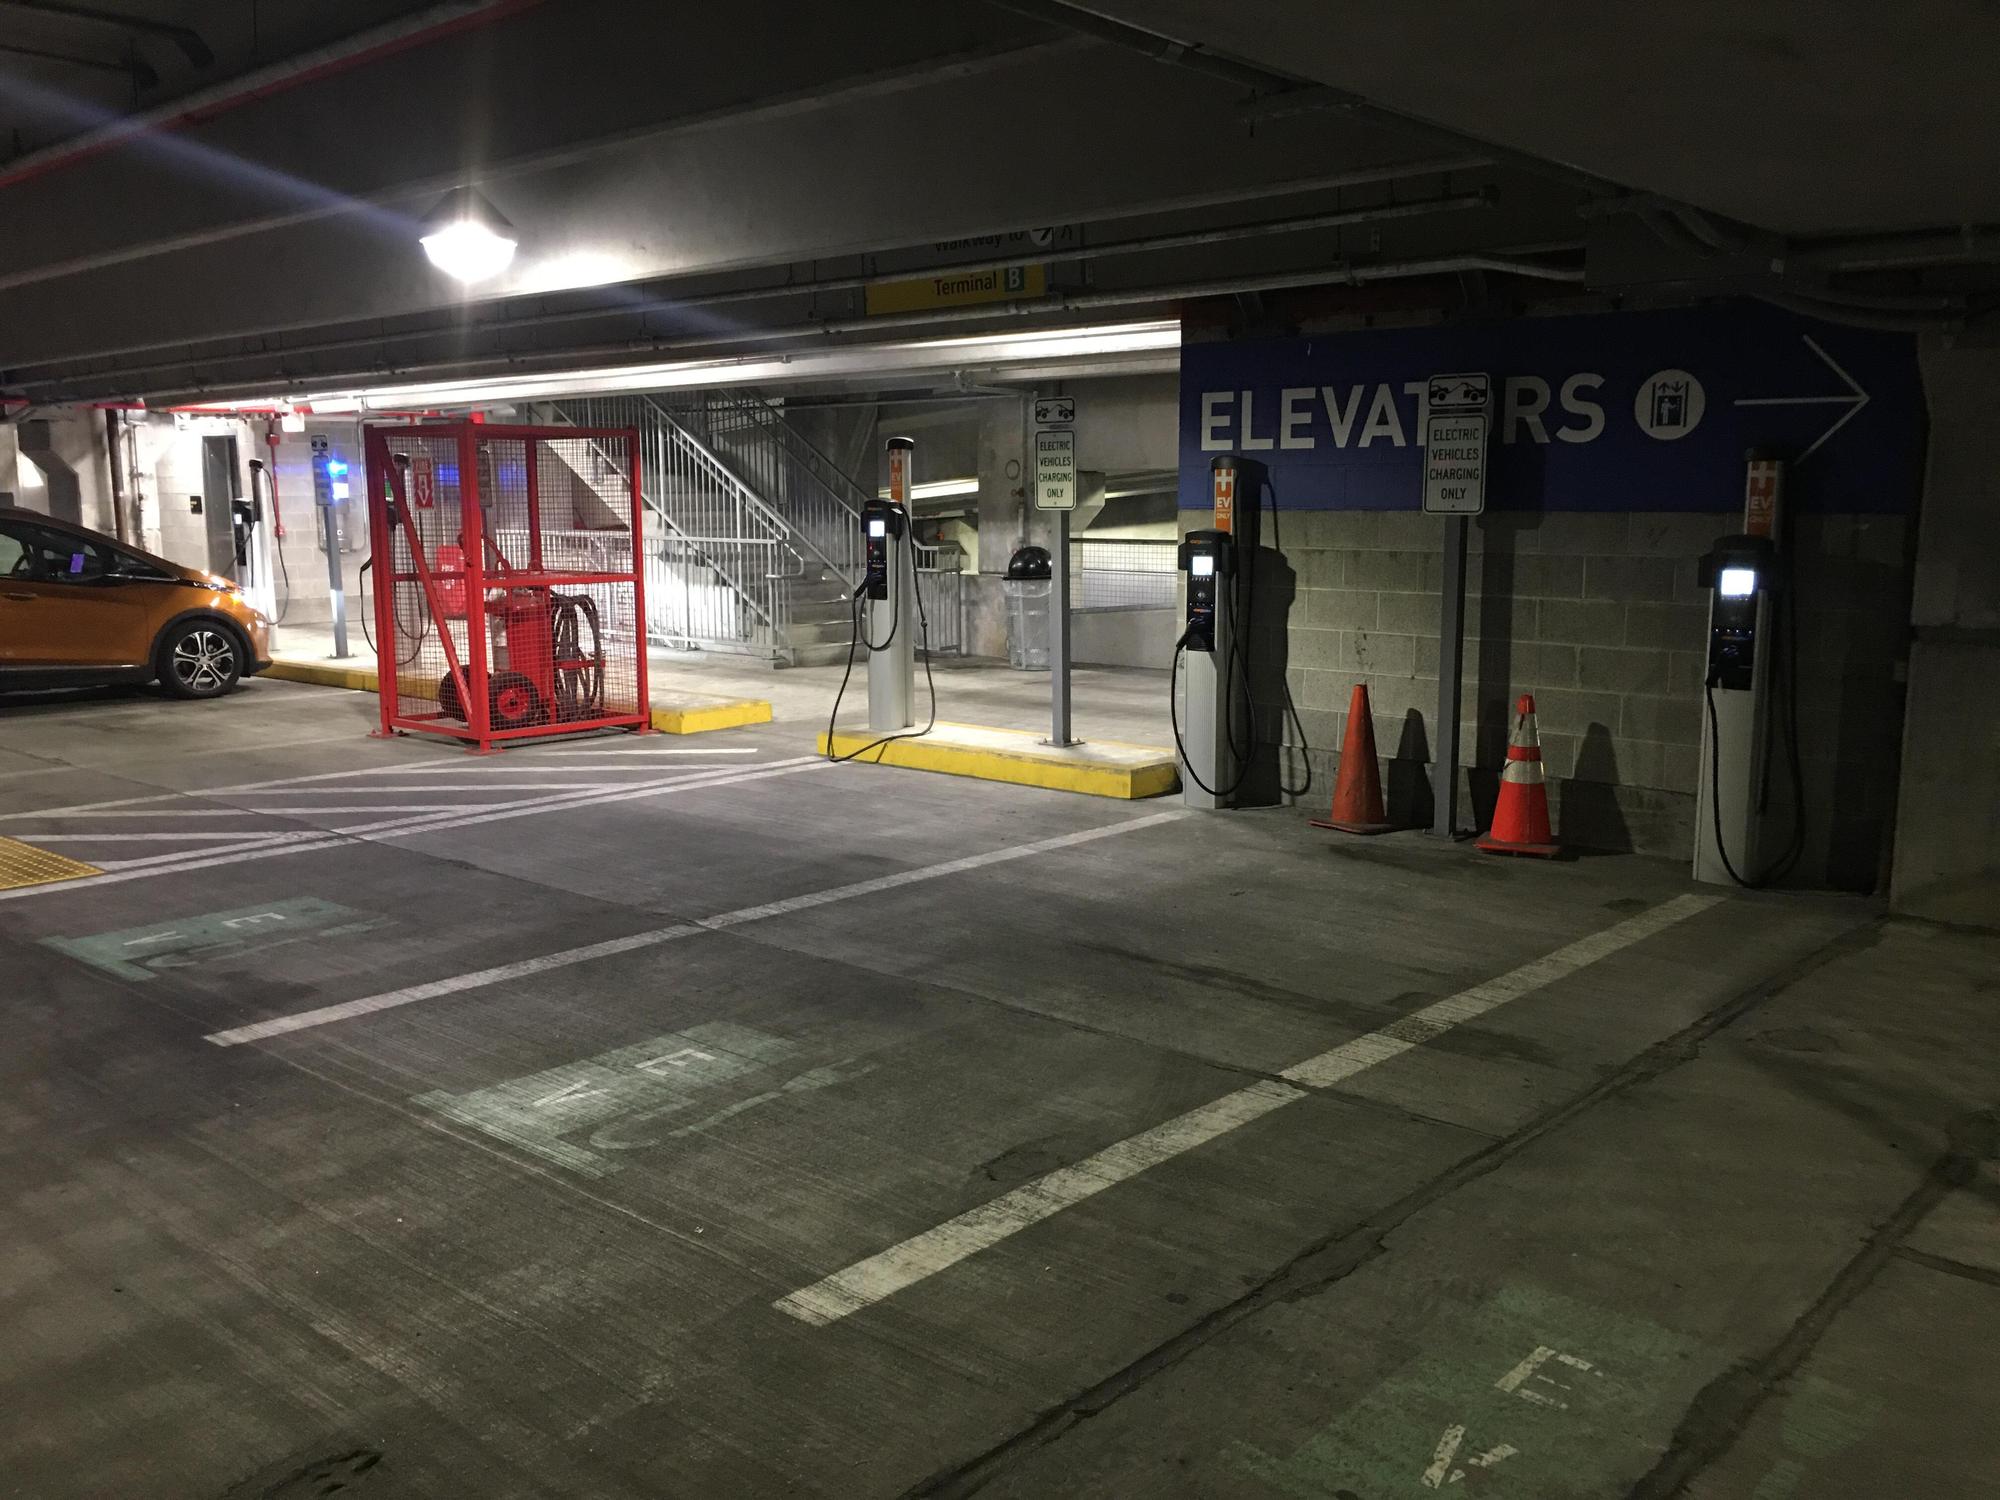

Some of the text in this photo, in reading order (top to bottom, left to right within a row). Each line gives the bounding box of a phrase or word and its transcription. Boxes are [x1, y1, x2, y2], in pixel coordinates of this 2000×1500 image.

[934, 268, 1021, 296] Terminal B
[1199, 372, 1606, 453] ELEVATRS
[1433, 428, 1479, 441] ELECTRIC
[1039, 440, 1071, 451] ELECTRIC
[1431, 448, 1479, 461] VEHICLES
[1039, 456, 1072, 467] VEHICLES
[1038, 473, 1073, 482] CHARGING
[1429, 468, 1480, 481] CHARGING
[1046, 488, 1064, 498] ONLY
[1440, 487, 1467, 500] ONLY
[1216, 496, 1231, 508] EV
[1749, 495, 1773, 509] EV
[1216, 512, 1231, 520] ONLY
